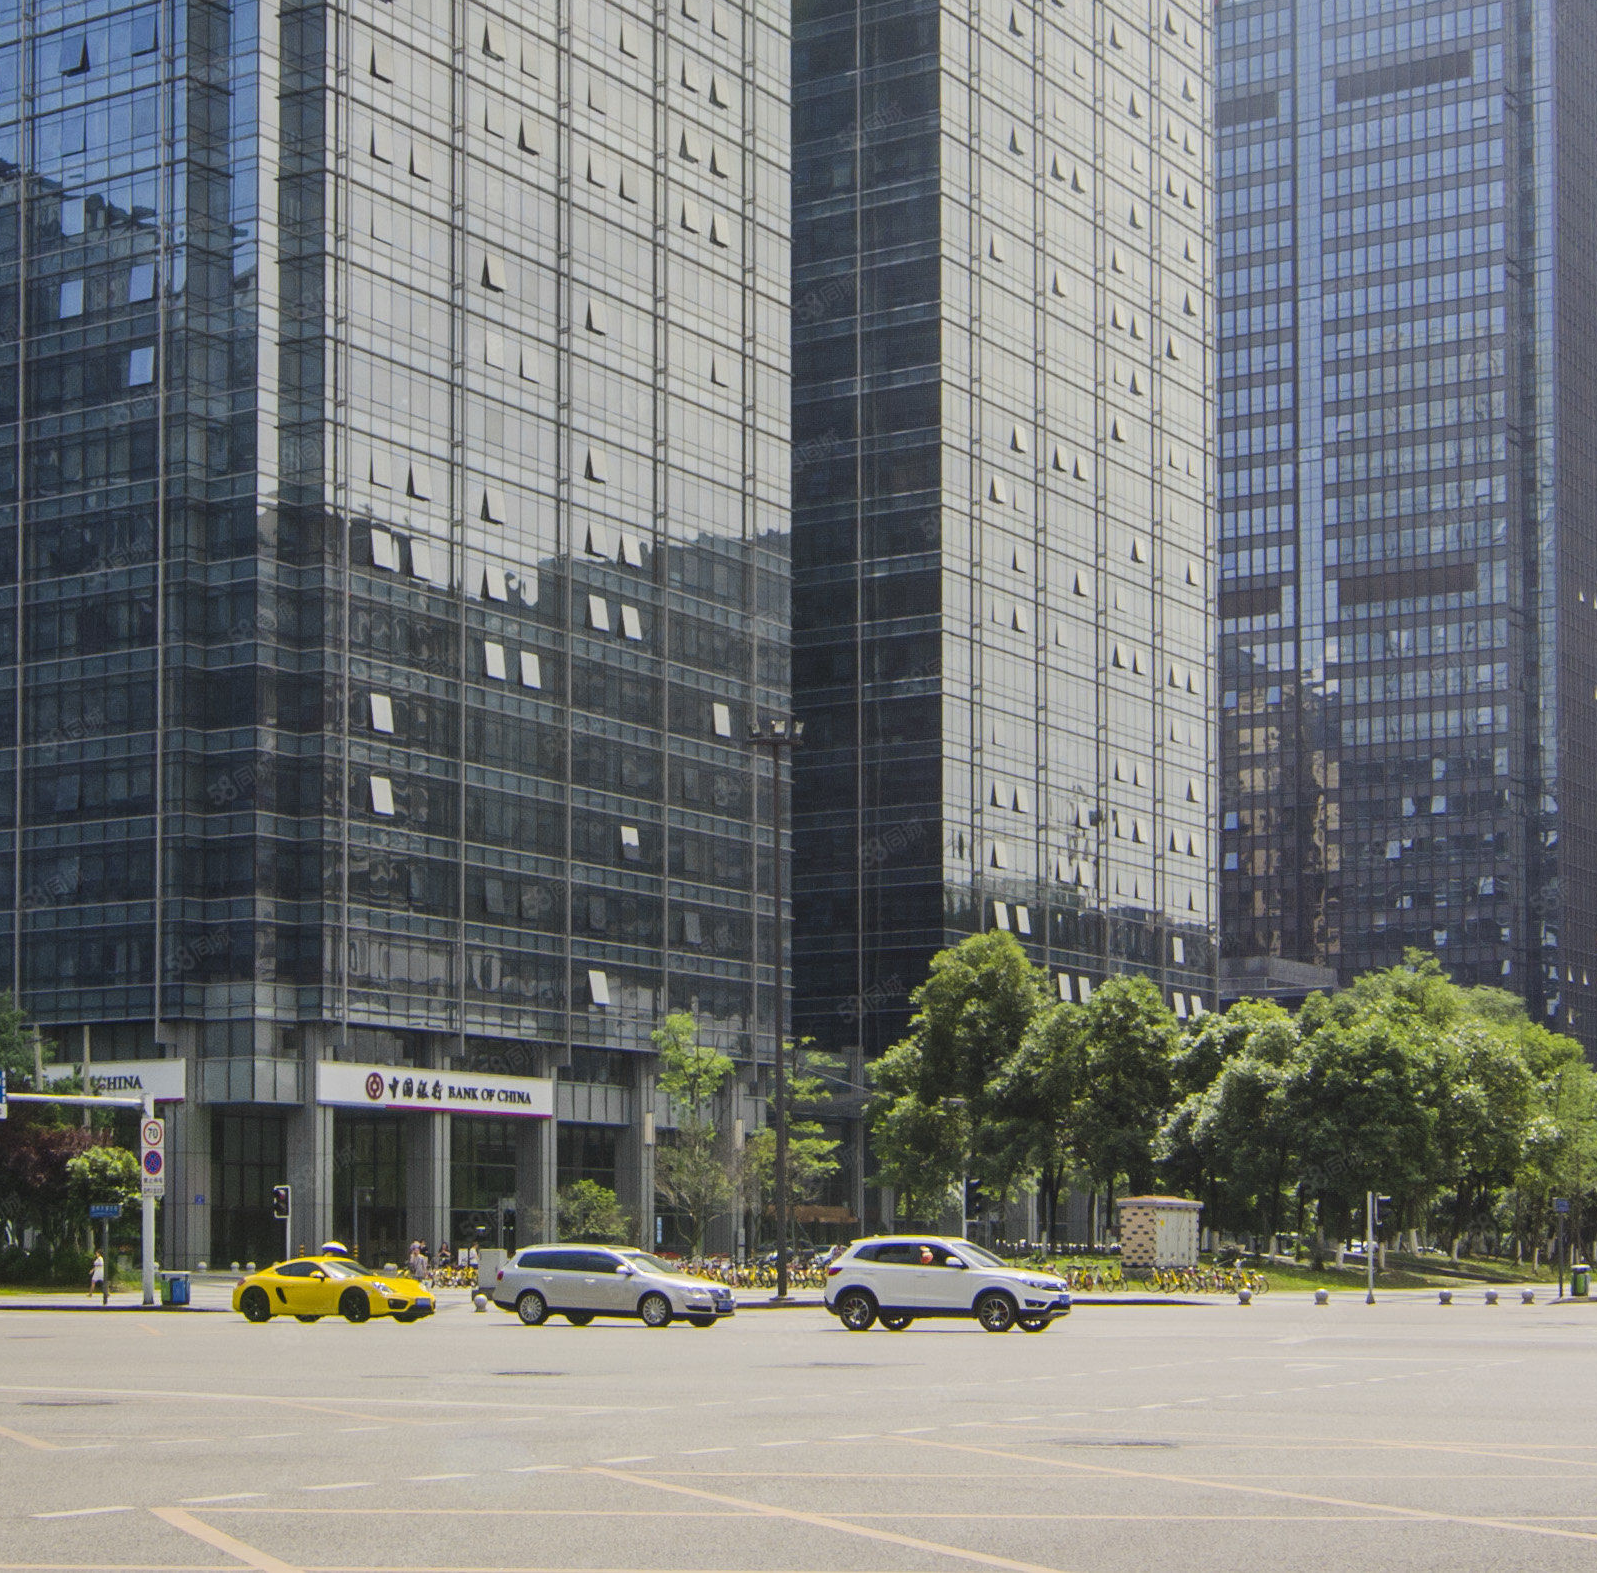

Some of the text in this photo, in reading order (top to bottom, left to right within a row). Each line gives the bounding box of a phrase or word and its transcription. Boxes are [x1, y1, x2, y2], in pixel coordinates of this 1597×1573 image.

[389, 1077, 532, 1104] 中国银行 BANK OF CHINA
[147, 1127, 159, 1139] 70
